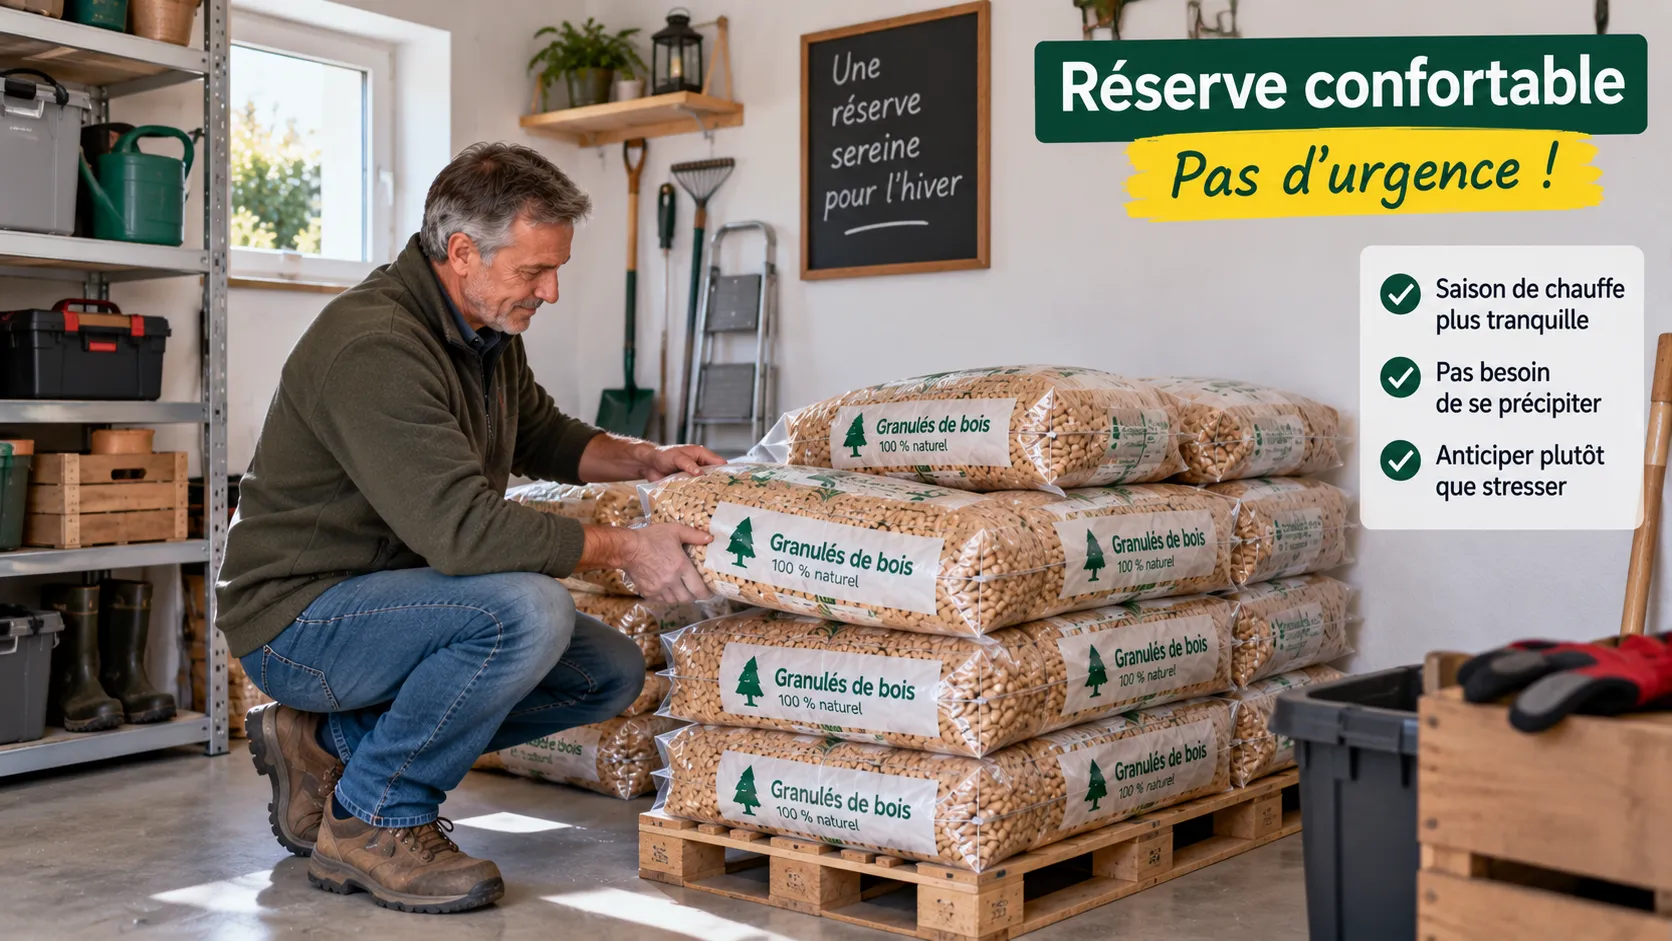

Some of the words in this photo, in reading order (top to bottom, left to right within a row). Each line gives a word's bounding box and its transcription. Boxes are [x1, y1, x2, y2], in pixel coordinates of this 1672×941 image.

[832, 51, 881, 85] Une
[831, 92, 921, 126] réserve
[830, 133, 920, 169] sereine
[823, 185, 877, 222] pour
[876, 416, 935, 435] Granulés
[939, 415, 956, 433] de
[960, 414, 990, 432] bois
[880, 441, 896, 453] 100
[900, 441, 910, 452] %
[913, 439, 948, 452] naturel
[770, 533, 845, 564] Granulés
[850, 549, 872, 569] de
[876, 552, 914, 576] bois
[1112, 529, 1164, 555] Granulés
[1167, 530, 1180, 548] de
[1183, 528, 1206, 547] bois
[772, 559, 794, 574] 100
[799, 564, 810, 578] %
[815, 569, 859, 588] naturel
[1117, 560, 1133, 573] 100
[1135, 559, 1143, 570] %
[1145, 555, 1175, 569] naturel
[1114, 644, 1166, 668] Granulés
[1168, 641, 1183, 660] de
[1185, 634, 1208, 653] bois
[775, 668, 847, 693] Granulés
[852, 675, 874, 696] de
[878, 677, 916, 701] bois
[1119, 673, 1134, 687] 100
[1136, 671, 1145, 683] %
[1147, 664, 1176, 681] naturel
[778, 694, 799, 707] 100
[803, 697, 815, 710] %
[819, 700, 863, 715] naturel
[1114, 754, 1166, 781] Granulés
[1168, 749, 1183, 768] de
[1185, 740, 1207, 762] bois
[771, 780, 843, 809] Granulés
[847, 793, 869, 813] de
[874, 797, 912, 820] bois
[1119, 784, 1135, 799] 100
[1136, 782, 1144, 794] %
[1146, 775, 1175, 793] naturel
[776, 806, 797, 820] 100
[801, 810, 813, 823] %
[817, 815, 860, 831] naturel
